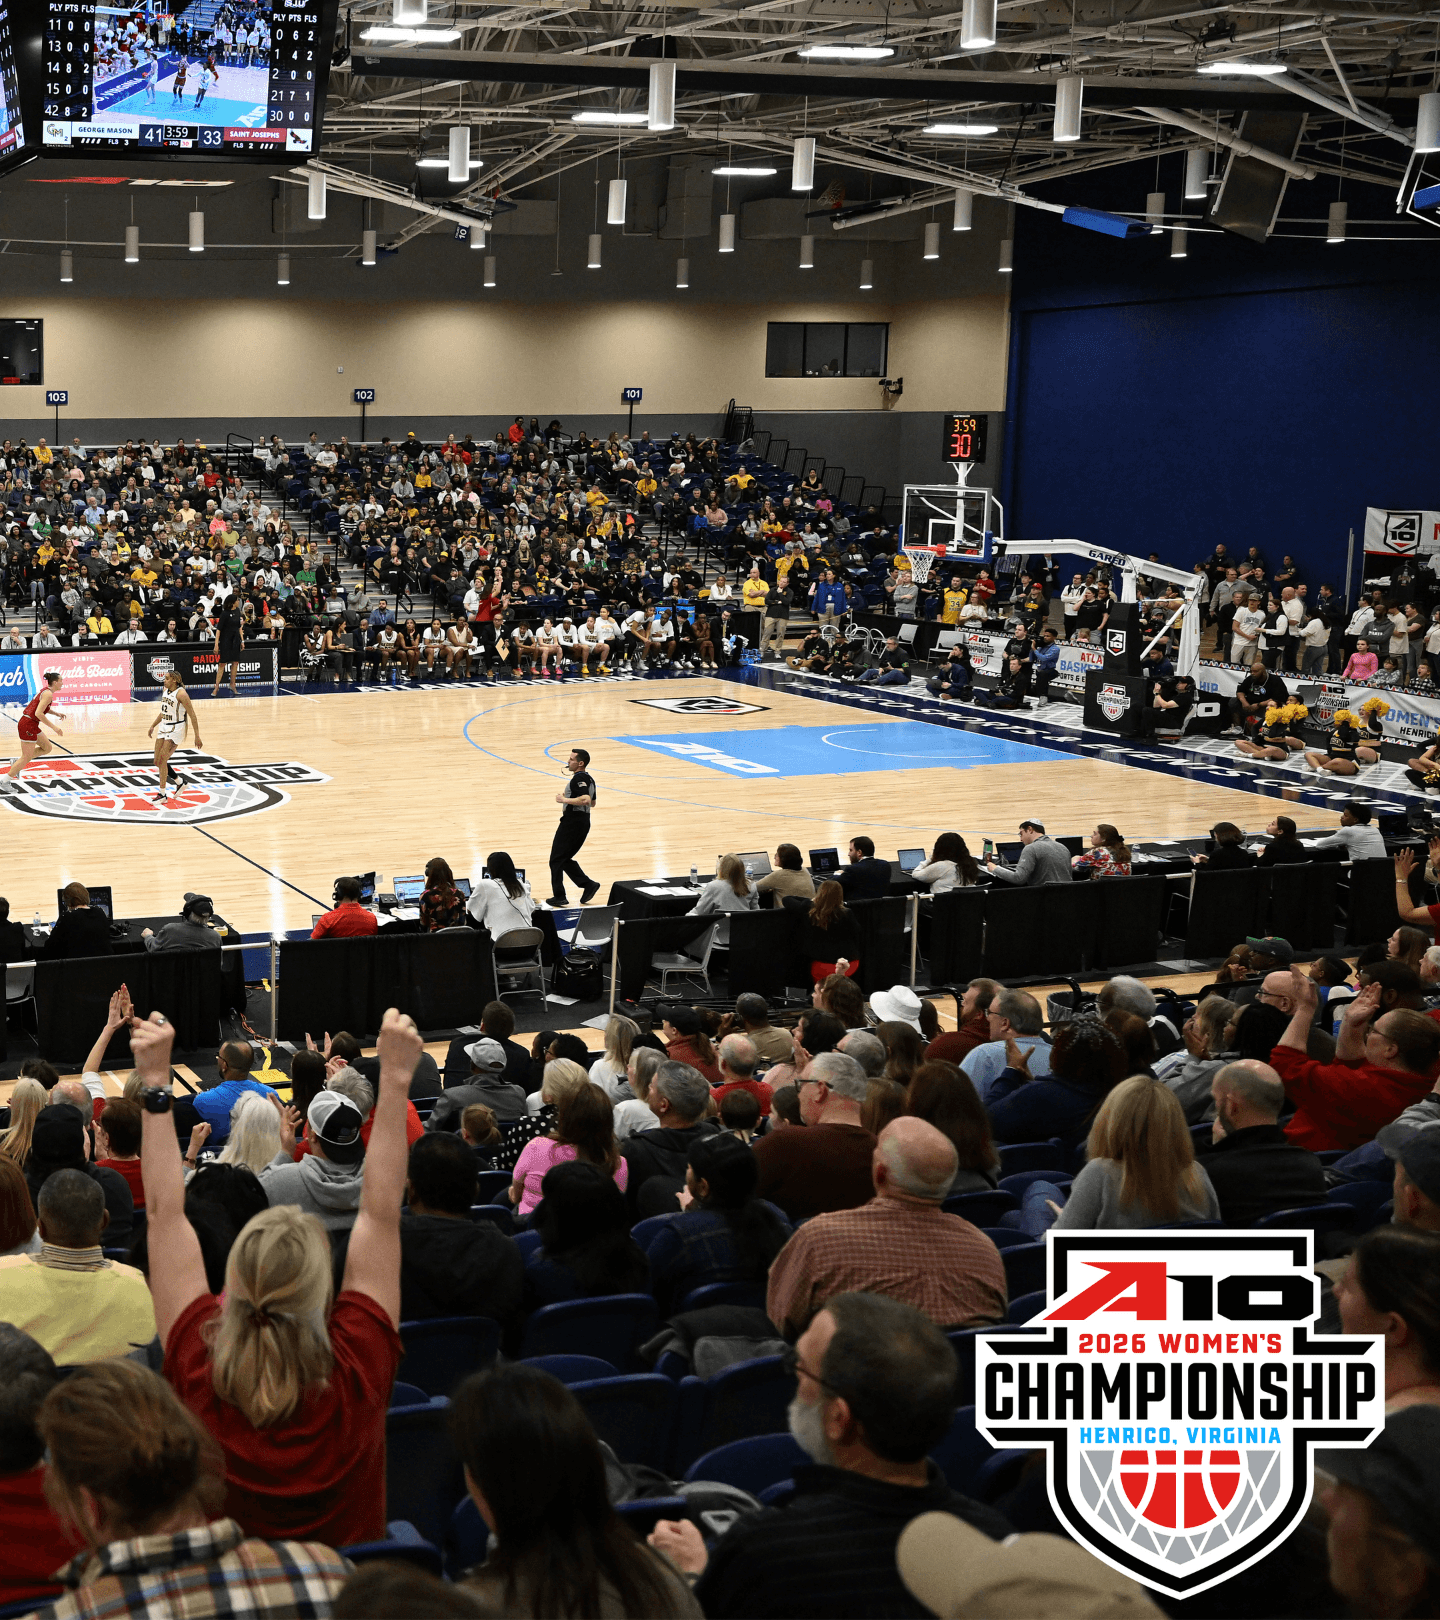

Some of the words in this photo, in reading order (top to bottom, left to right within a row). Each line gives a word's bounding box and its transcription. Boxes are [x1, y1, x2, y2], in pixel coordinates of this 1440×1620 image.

[49, 3, 63, 12] PLY
[65, 4, 79, 12] PTS
[81, 5, 95, 13] FLS
[273, 13, 286, 21] PLY
[288, 14, 302, 22] PTS
[304, 15, 317, 23] FLS
[49, 19, 61, 30] 11
[67, 21, 74, 31] 0
[84, 21, 90, 32] 0
[276, 29, 283, 40] 0
[293, 30, 299, 40] 6
[308, 31, 314, 41] 2
[48, 40, 61, 52] 13
[66, 42, 73, 52] 0
[83, 43, 89, 53] 0
[275, 49, 279, 59] 1
[292, 50, 298, 60] 4
[307, 51, 313, 60] 2
[47, 62, 60, 73] 14
[66, 63, 72, 73] 8
[83, 64, 89, 74] 2
[272, 68, 279, 79] 2
[291, 70, 297, 80] 0
[306, 70, 312, 80] 0
[46, 83, 60, 94] 15
[65, 84, 71, 94] 0
[82, 85, 88, 95] 0
[271, 90, 283, 101] 21
[289, 91, 295, 101] 7
[305, 91, 310, 101] 1
[44, 105, 59, 116] 42
[64, 106, 70, 117] 8
[81, 107, 88, 117] 2
[269, 110, 283, 121] 30
[288, 111, 294, 121] 0
[304, 112, 310, 122] 0
[144, 128, 162, 142] 41
[166, 126, 188, 139] 3:59
[203, 131, 221, 145] 33
[48, 392, 66, 402] 103
[355, 390, 373, 400] 102
[625, 389, 640, 398] 101
[953, 418, 976, 432] 3:59
[950, 433, 972, 457] 30
[1088, 550, 1126, 566] GARED
[950, 600, 960, 608] 34
[968, 634, 990, 644] A10
[86, 663, 124, 678] Beach
[193, 662, 261, 674] CHAMIOSHIP
[1103, 687, 1125, 696] A10
[1384, 708, 1440, 730] OMEN'S
[633, 739, 780, 774] A10
